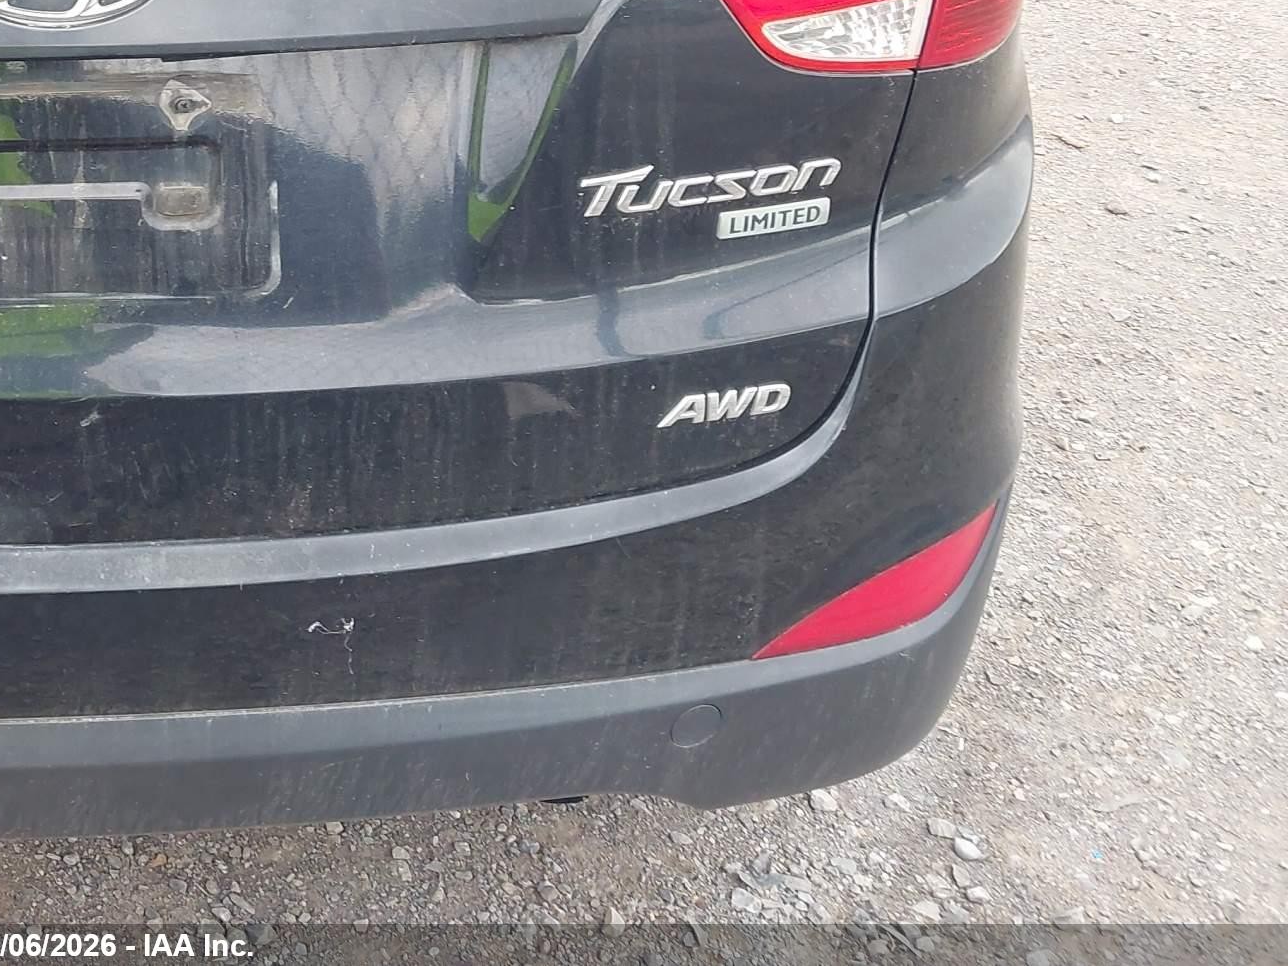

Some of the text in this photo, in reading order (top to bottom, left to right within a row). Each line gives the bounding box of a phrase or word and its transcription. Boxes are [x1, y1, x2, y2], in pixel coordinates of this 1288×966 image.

[580, 157, 842, 218] TUCSON
[729, 205, 821, 234] LIMITED
[656, 383, 792, 428] AWD
